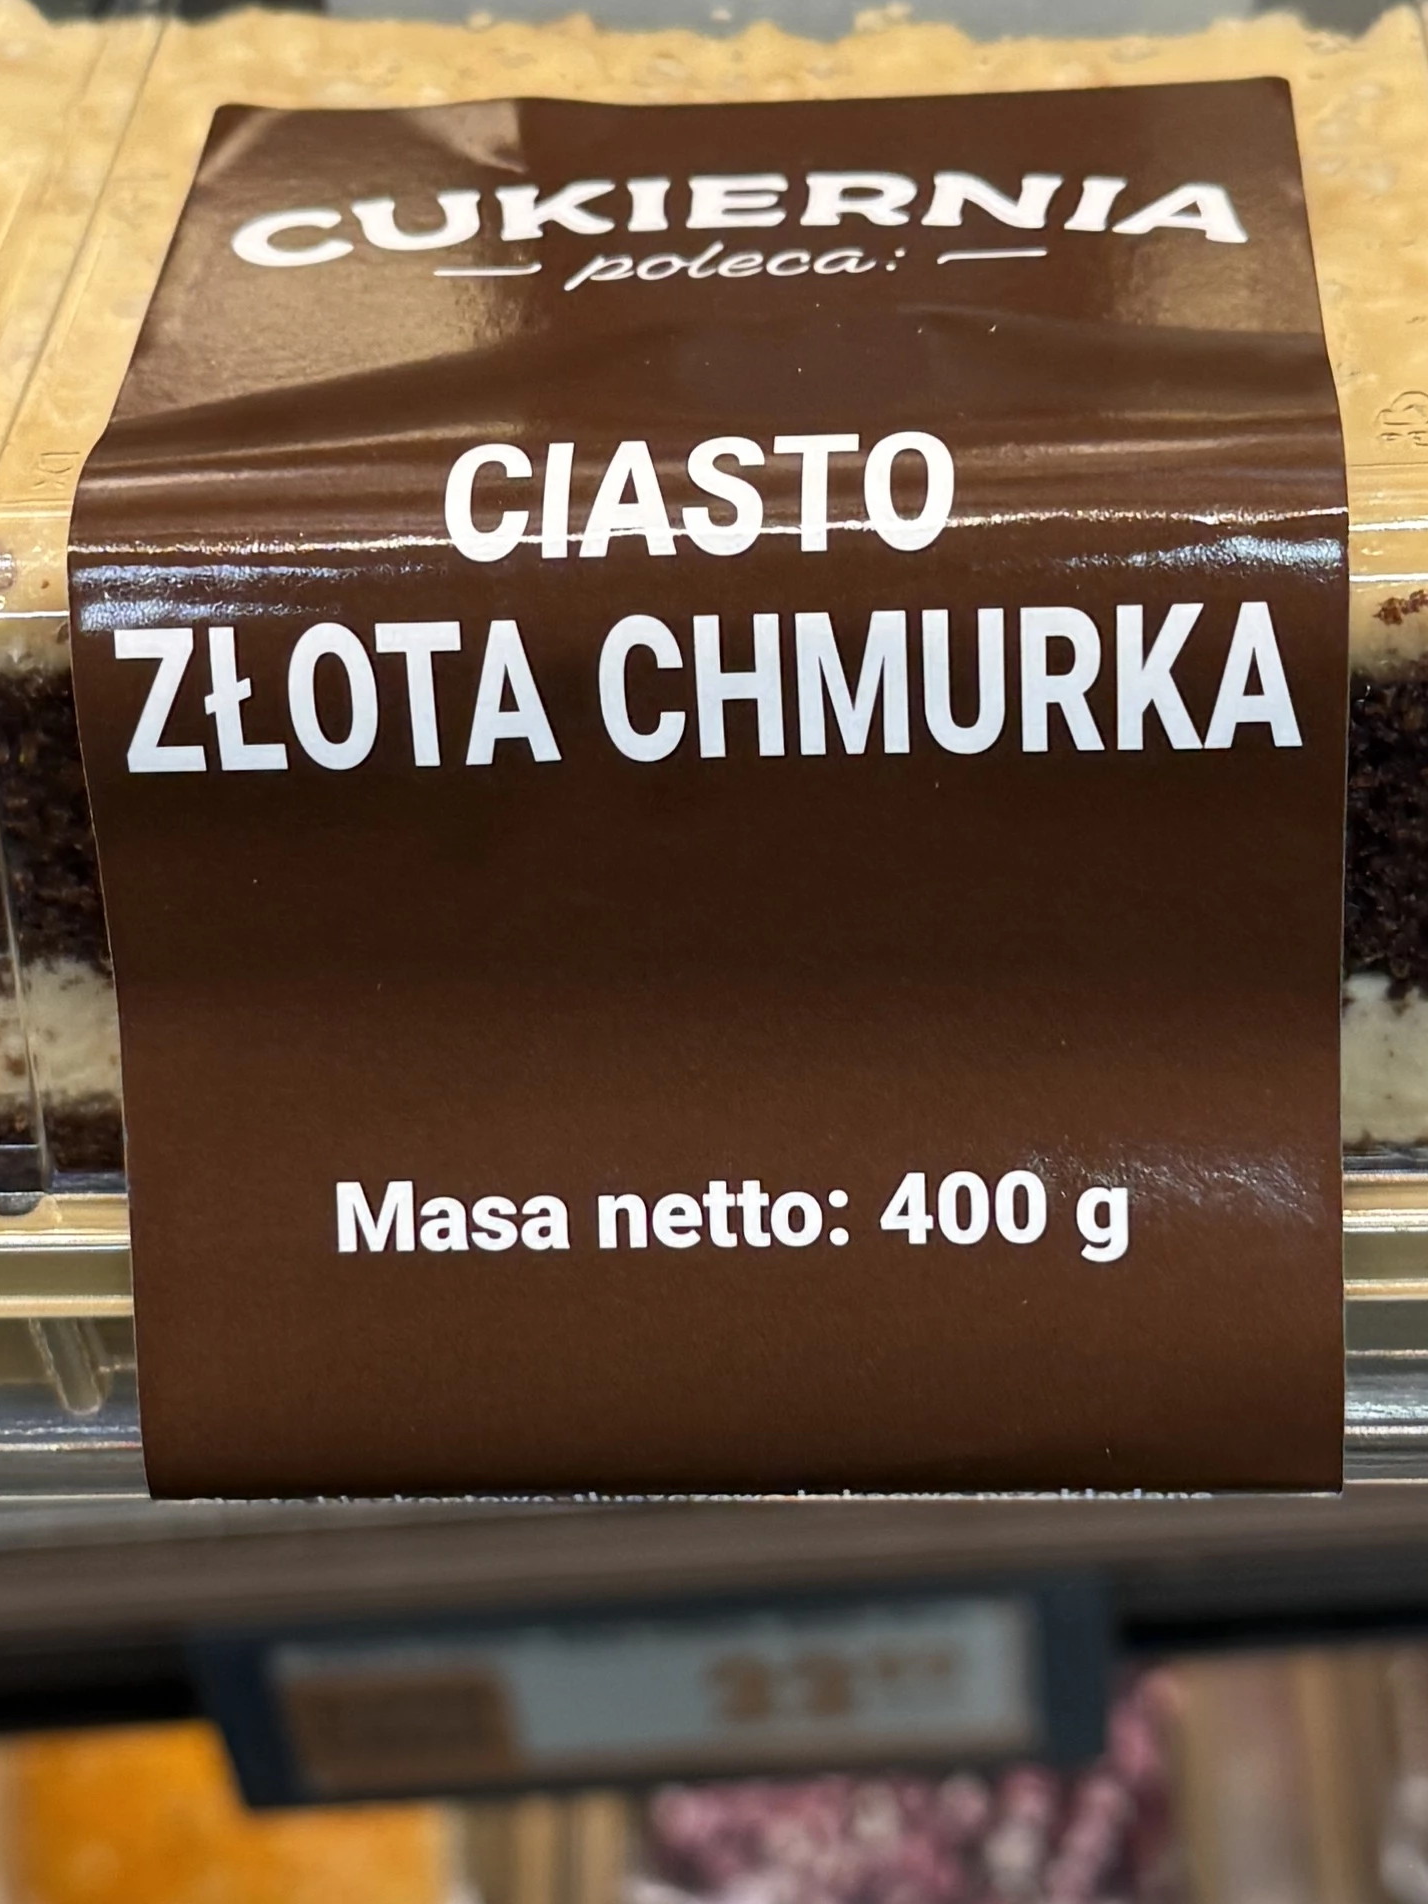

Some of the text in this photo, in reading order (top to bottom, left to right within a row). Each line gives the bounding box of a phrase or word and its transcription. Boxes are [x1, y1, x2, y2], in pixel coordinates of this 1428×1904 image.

[231, 170, 1248, 267] CUKIERNIA
[564, 239, 906, 292] poleca:
[443, 431, 956, 562] CIASTO
[114, 601, 1303, 773] ZŁOTA CHMURKA
[336, 1169, 1129, 1263] Masa netto: 400 g
